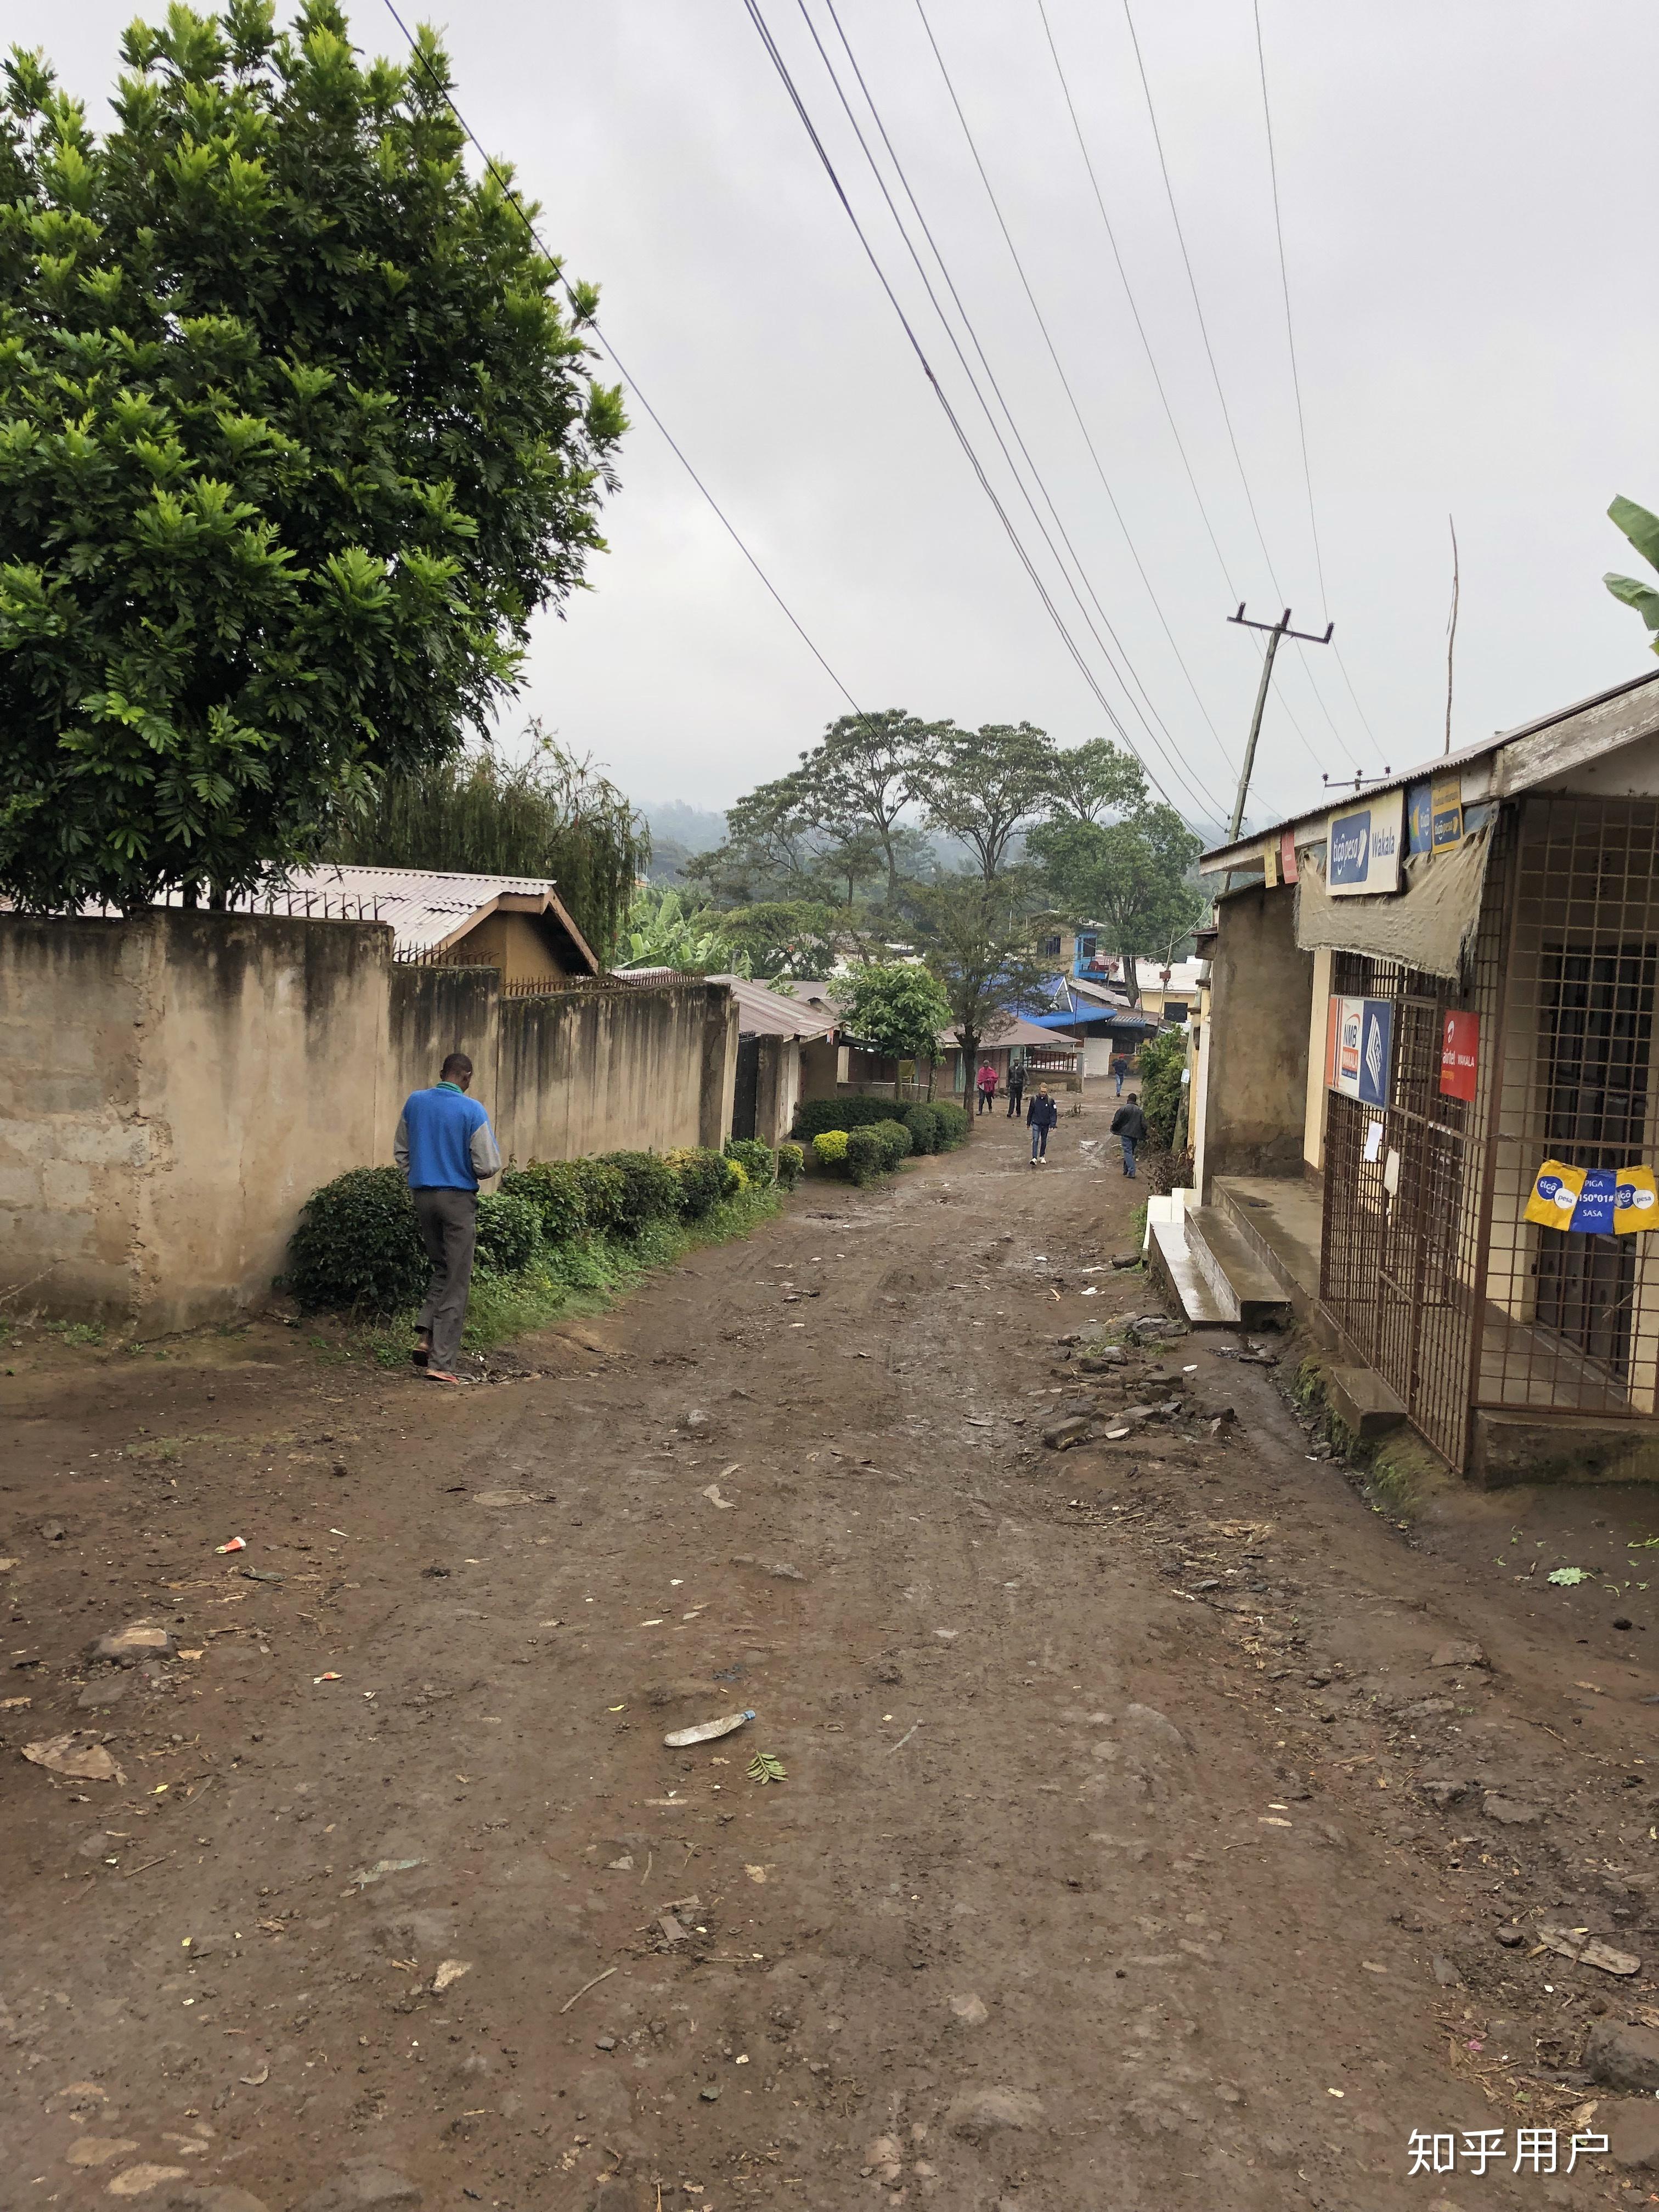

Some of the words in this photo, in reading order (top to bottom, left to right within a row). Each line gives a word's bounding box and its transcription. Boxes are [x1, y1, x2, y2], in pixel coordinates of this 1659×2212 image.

[1372, 827, 1395, 858] Wakala
[1344, 1024, 1357, 1048] NMB
[1442, 1048, 1455, 1065] airtel
[1457, 1054, 1475, 1067] WAKALA
[1540, 1180, 1557, 1193] tigo
[1558, 1195, 1572, 1204] pesa
[1583, 1209, 1602, 1217] SASA
